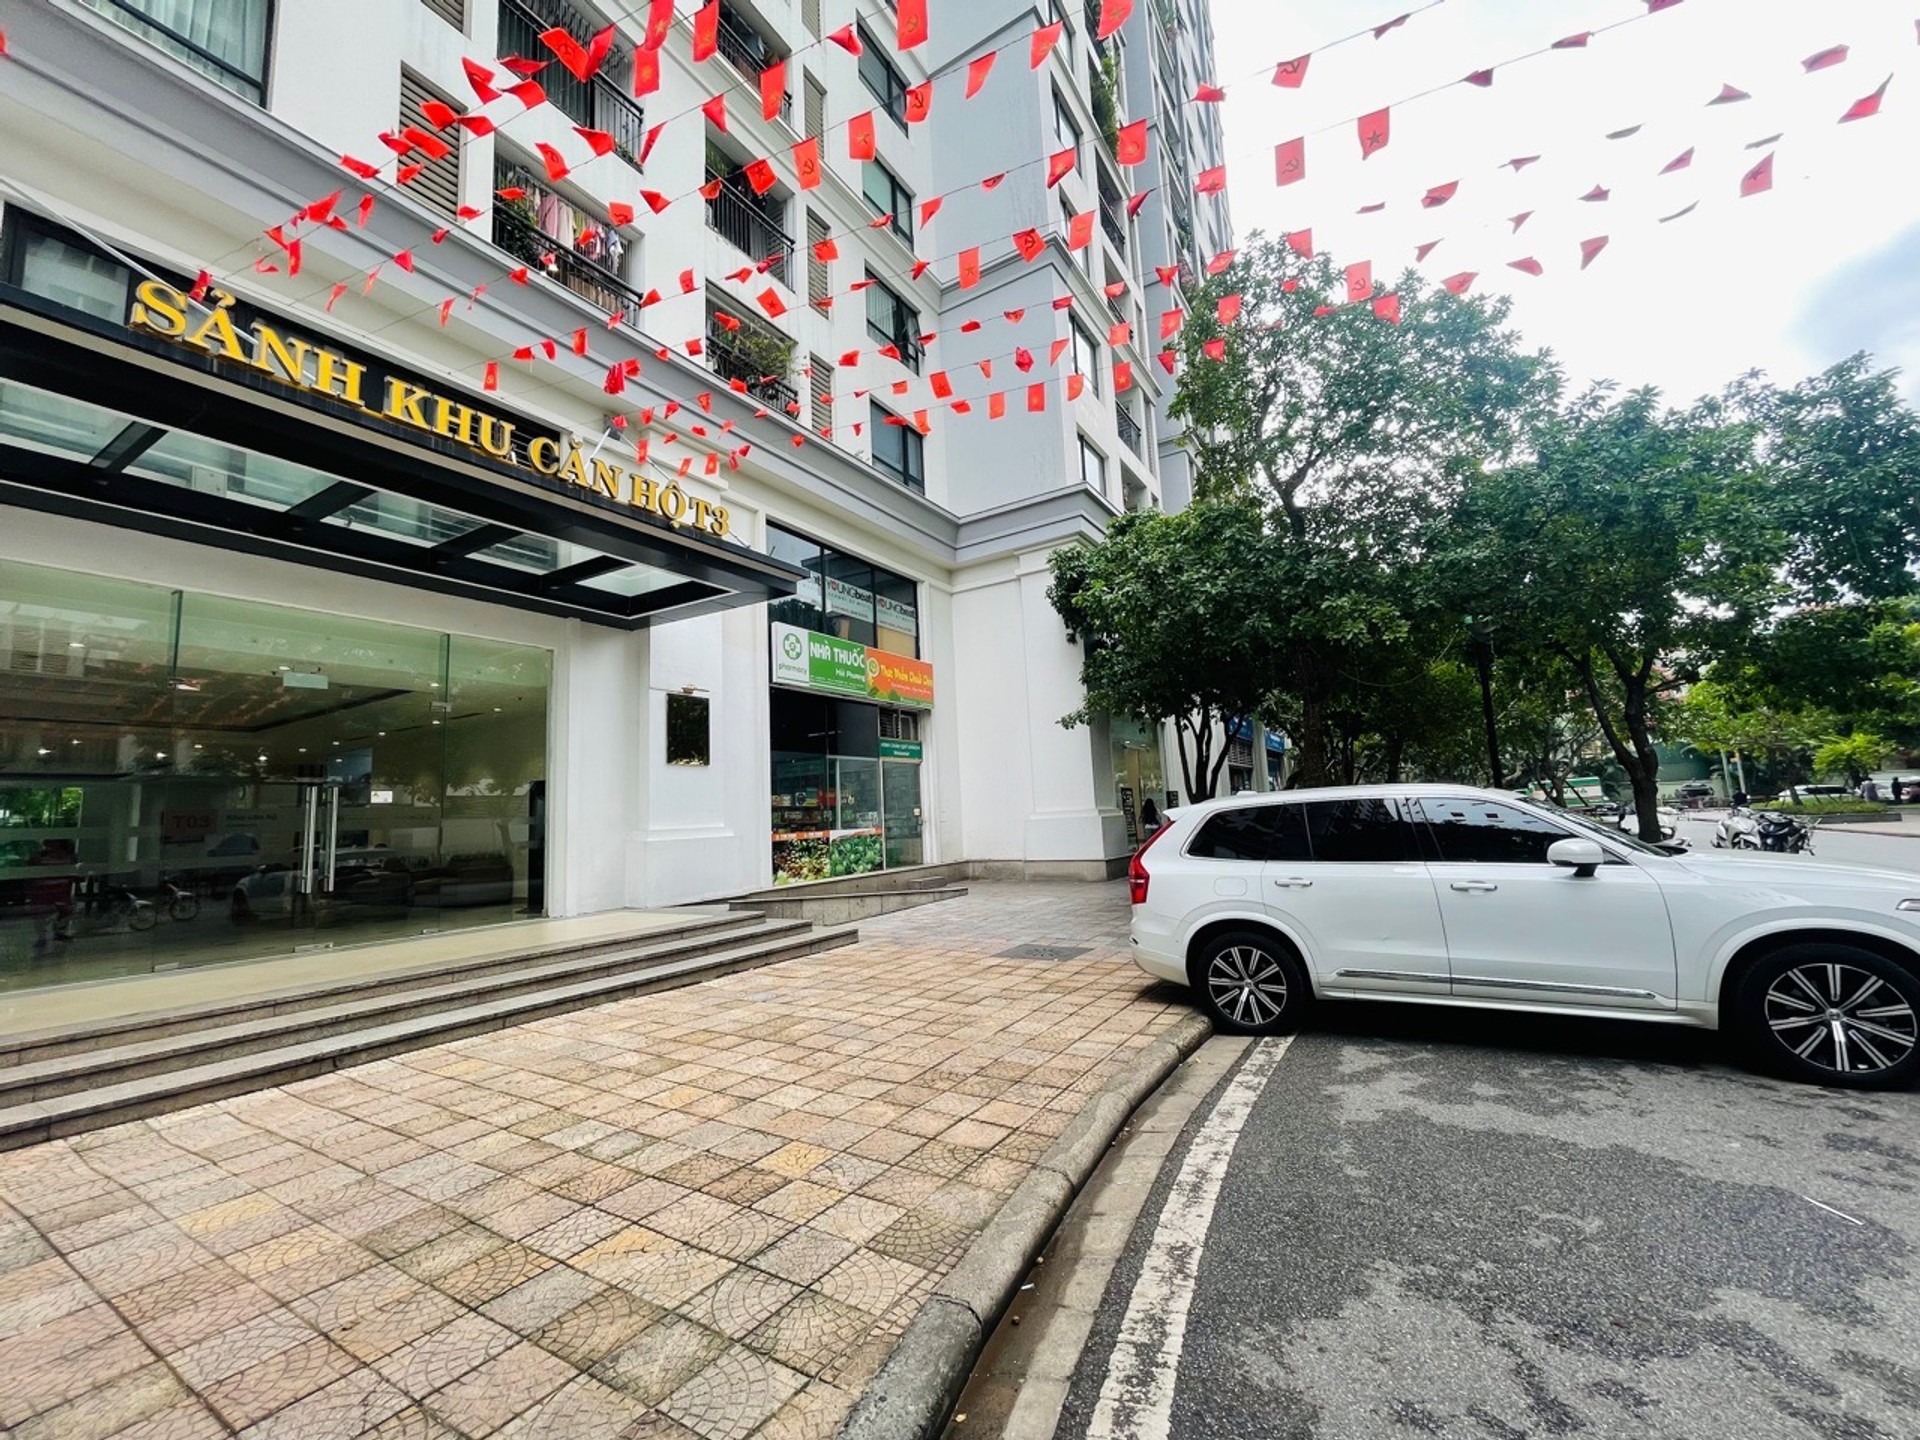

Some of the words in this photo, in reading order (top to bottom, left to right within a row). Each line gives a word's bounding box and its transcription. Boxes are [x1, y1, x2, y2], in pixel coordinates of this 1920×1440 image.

[132, 280, 367, 409] SẢNH
[385, 375, 516, 458] KHU
[527, 431, 624, 499] CĂN
[630, 473, 687, 530] HỘ
[690, 499, 731, 538] T3
[810, 640, 832, 661] NHÀ
[833, 647, 867, 669] THUỐC
